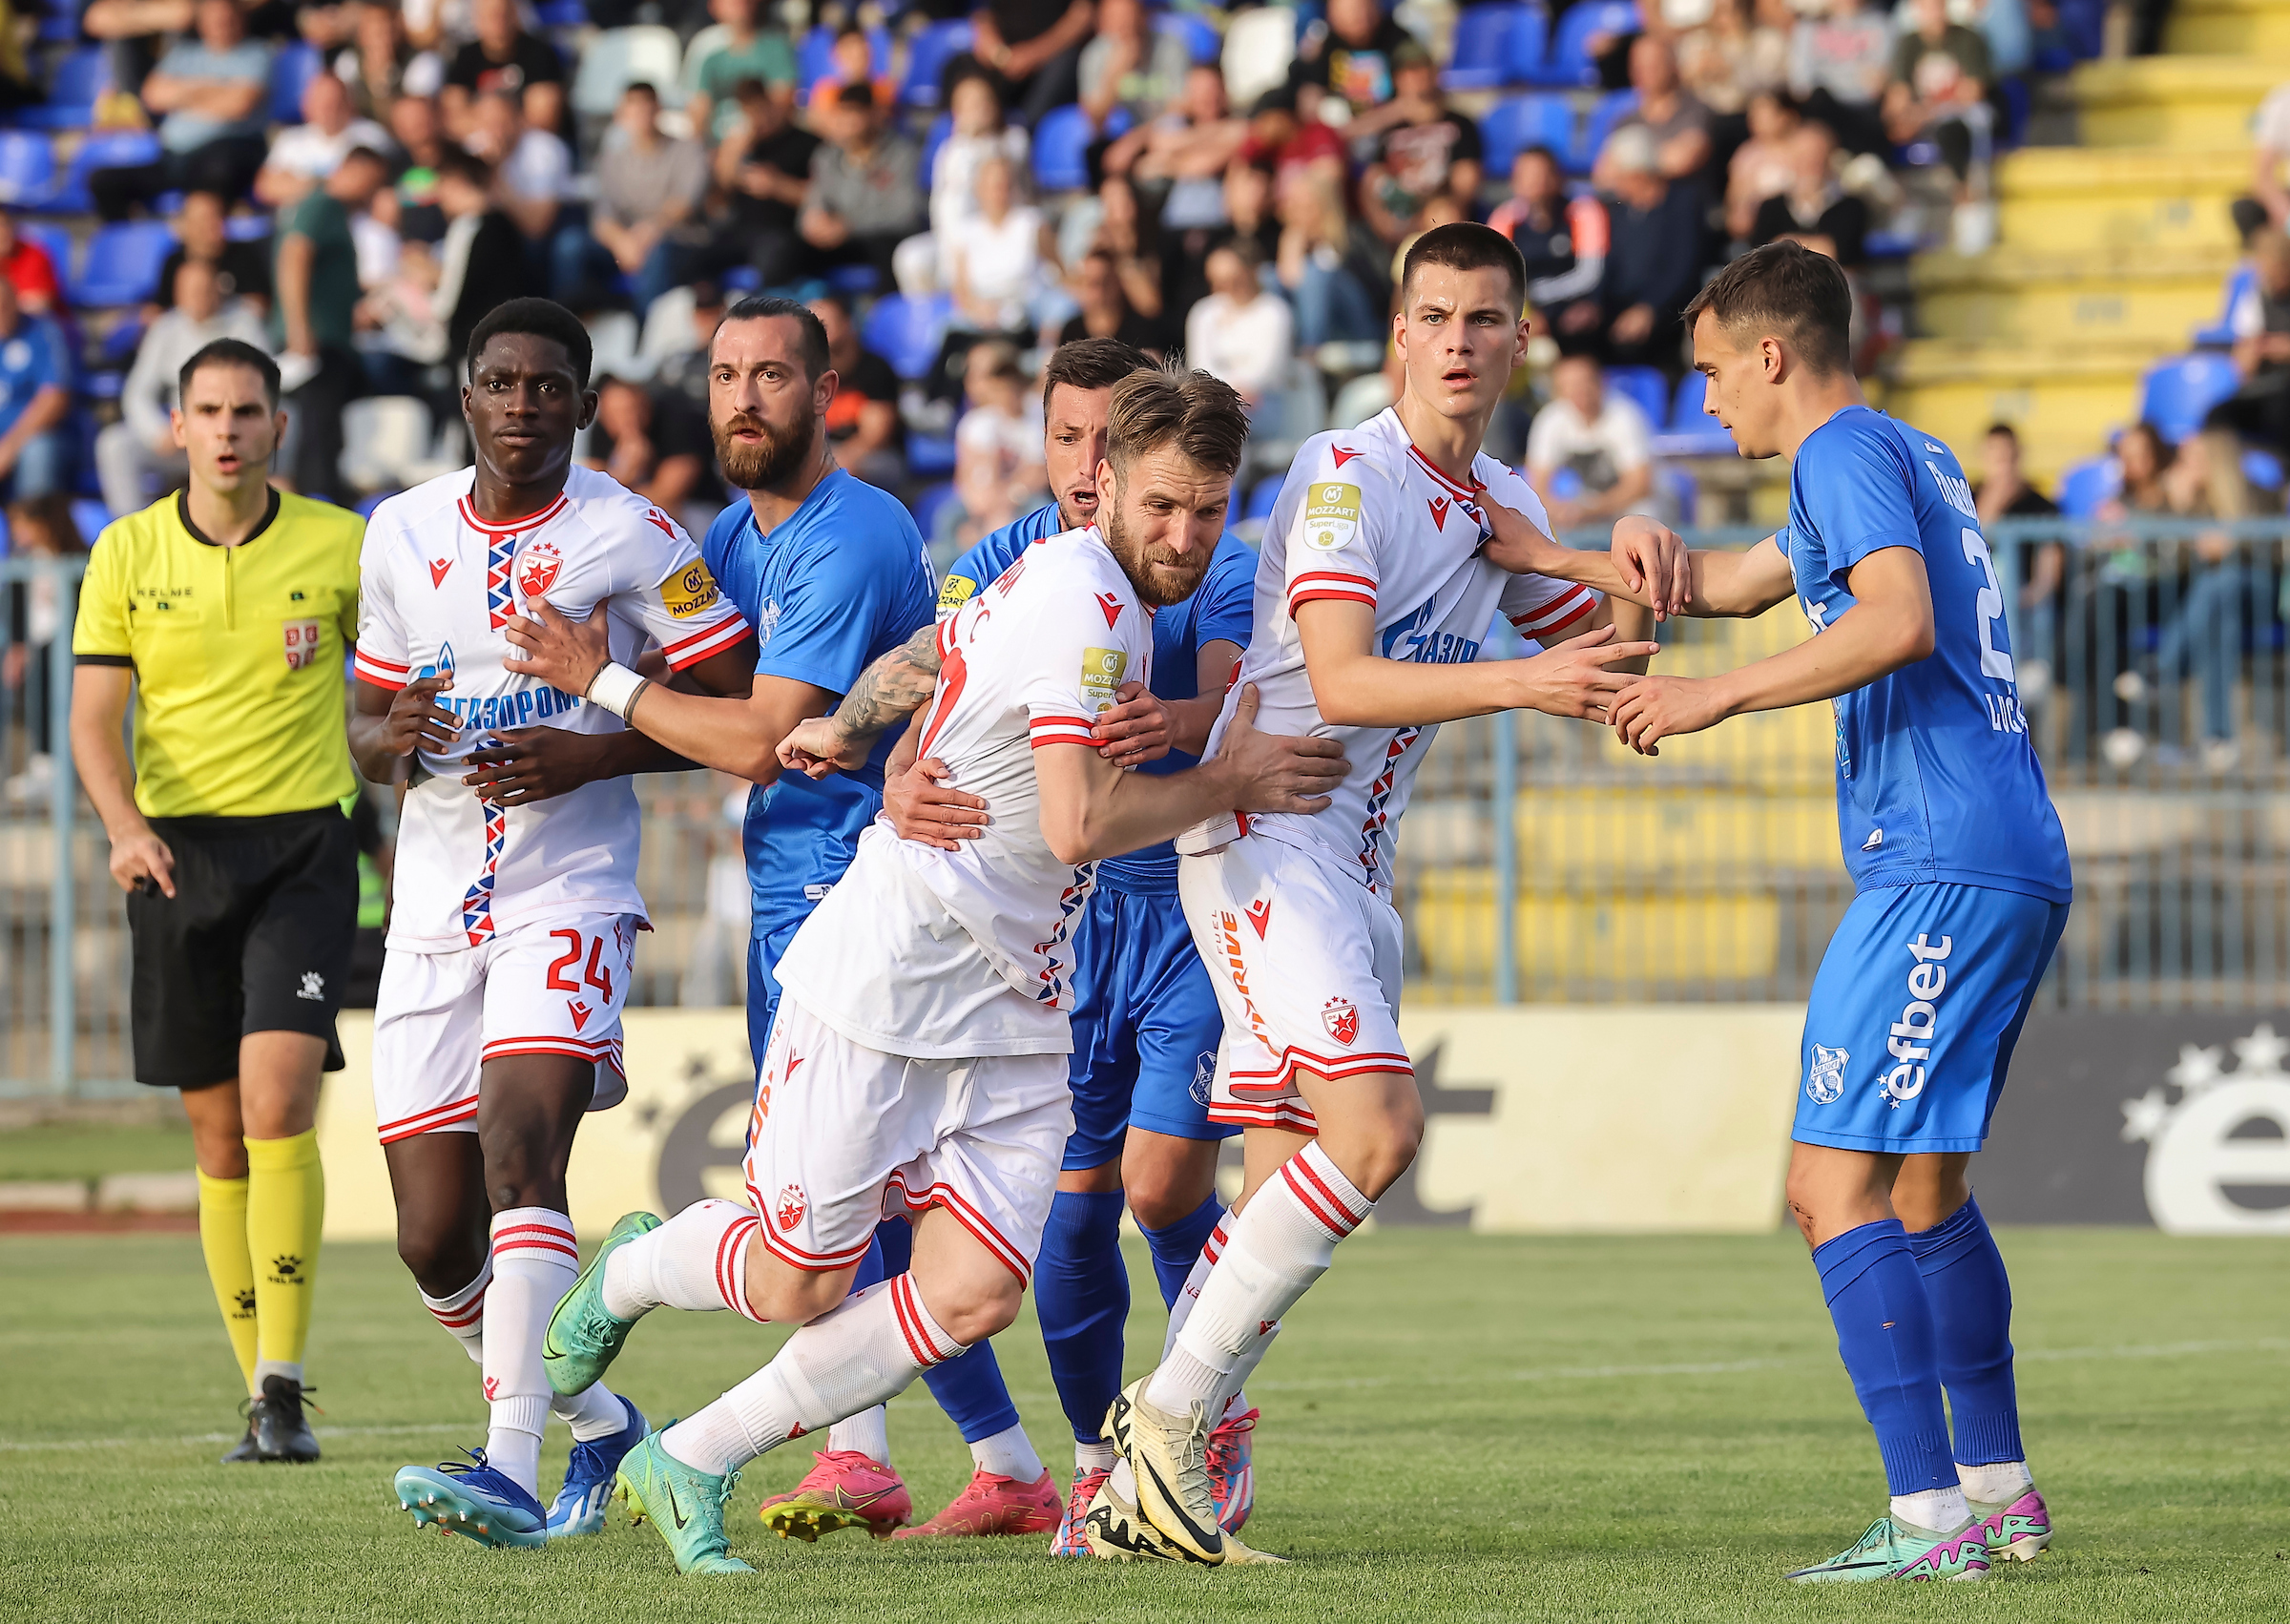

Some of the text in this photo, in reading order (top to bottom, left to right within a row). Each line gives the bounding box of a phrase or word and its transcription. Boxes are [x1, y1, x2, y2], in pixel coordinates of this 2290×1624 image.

[1307, 506, 1356, 517] MOZZART
[1309, 520, 1349, 531] SuperLiga
[455, 686, 580, 730] ГАЗПРОМ
[1088, 689, 1114, 699] Super
[1212, 909, 1224, 955] FUEL
[547, 928, 613, 1005] 24
[1887, 933, 1952, 1100] efbet
